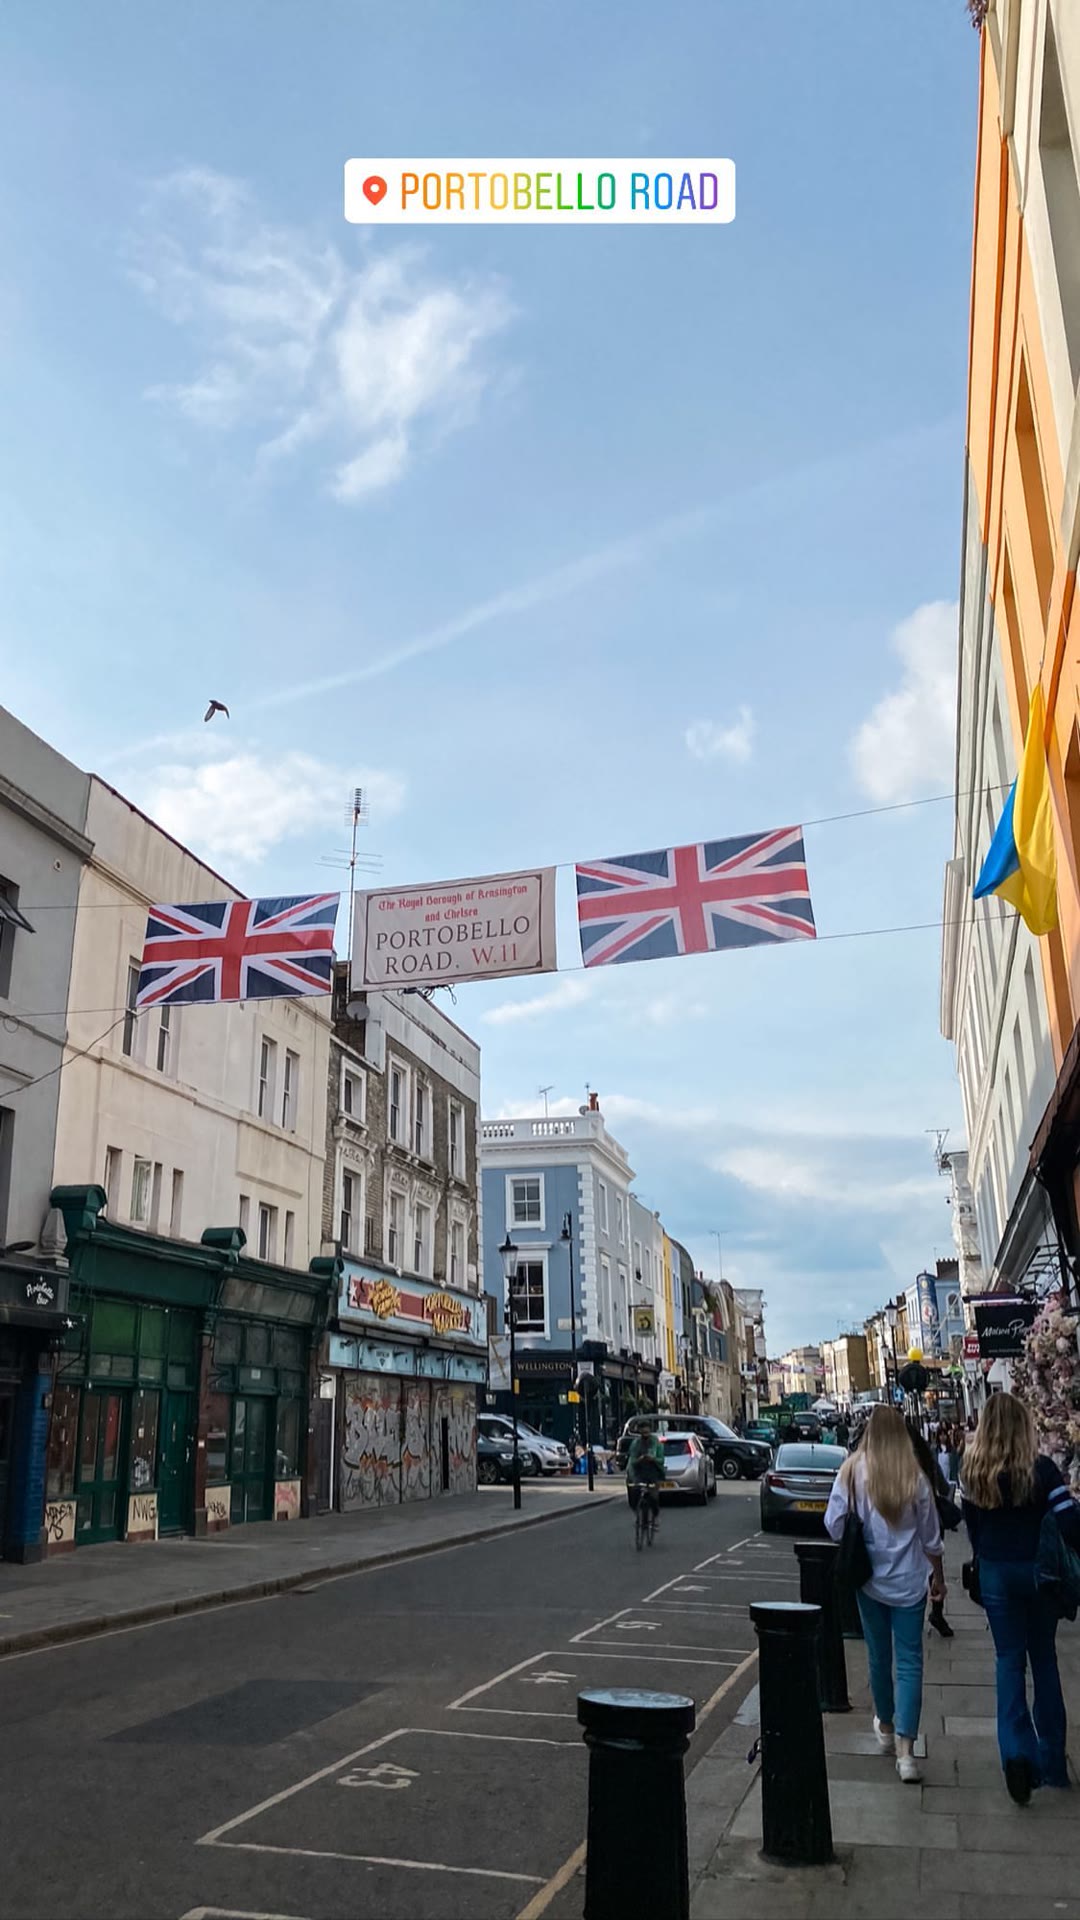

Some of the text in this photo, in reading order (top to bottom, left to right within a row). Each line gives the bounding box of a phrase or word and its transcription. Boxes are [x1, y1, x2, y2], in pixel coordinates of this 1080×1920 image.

[379, 884, 528, 911] The Royal Borough of Kensington
[425, 907, 478, 922] and Chelsea
[376, 915, 530, 950] PORTOBELLO
[385, 943, 518, 975] ROAD. W.11
[517, 1362, 572, 1371] WELLINGTON
[336, 1763, 421, 1790] 43
